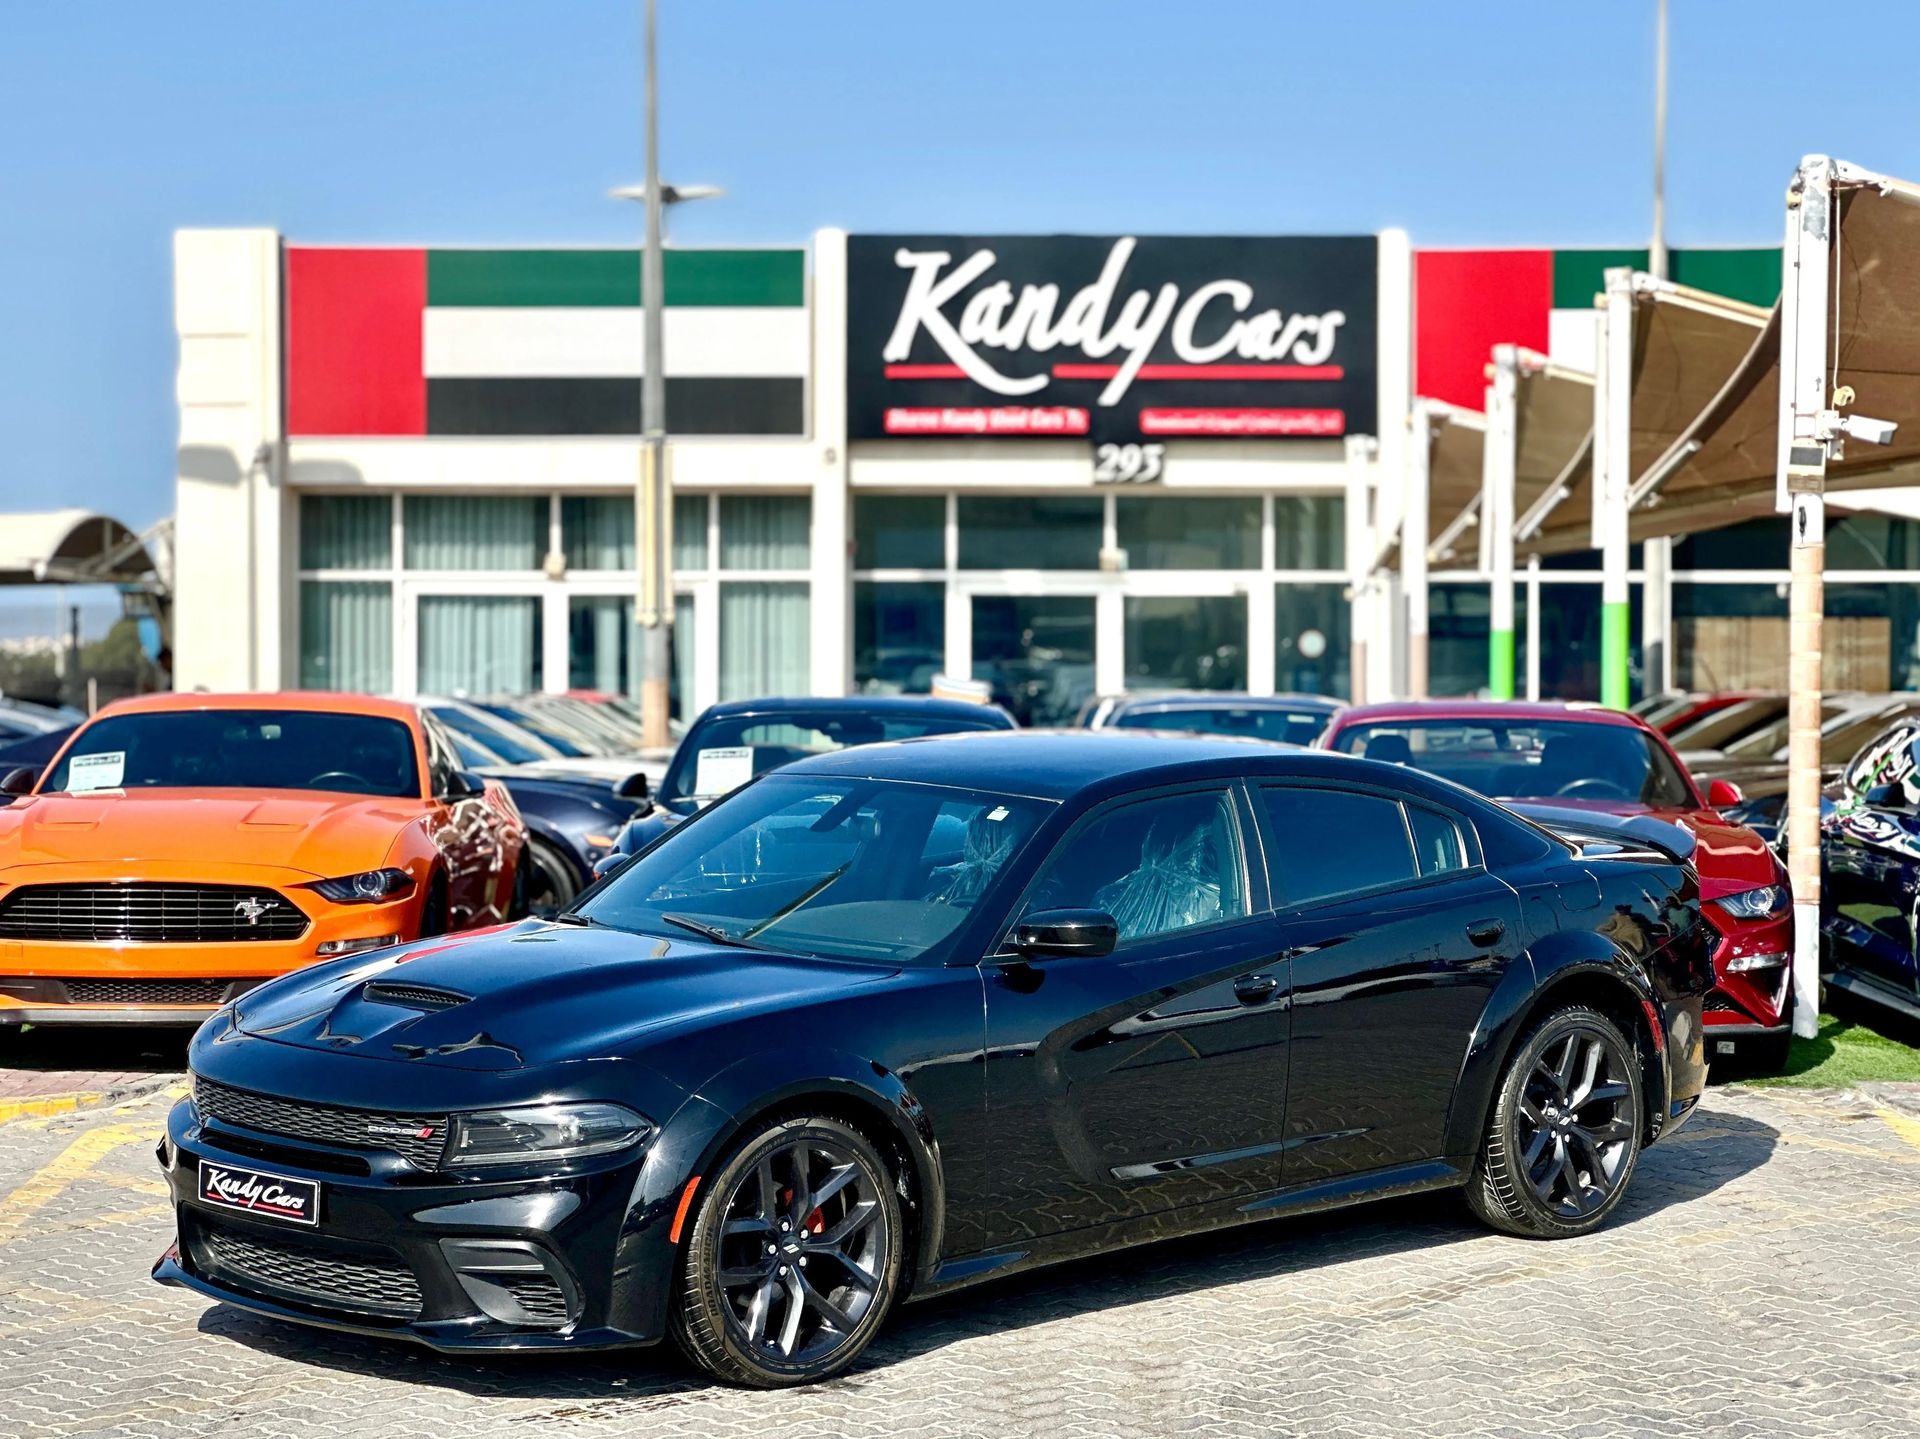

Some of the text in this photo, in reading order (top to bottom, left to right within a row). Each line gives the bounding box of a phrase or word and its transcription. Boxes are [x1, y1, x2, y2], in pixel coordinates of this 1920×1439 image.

[883, 236, 1346, 406] Kandy Cars
[1094, 442, 1166, 482] 295
[206, 1168, 305, 1209] Kandy Cars
